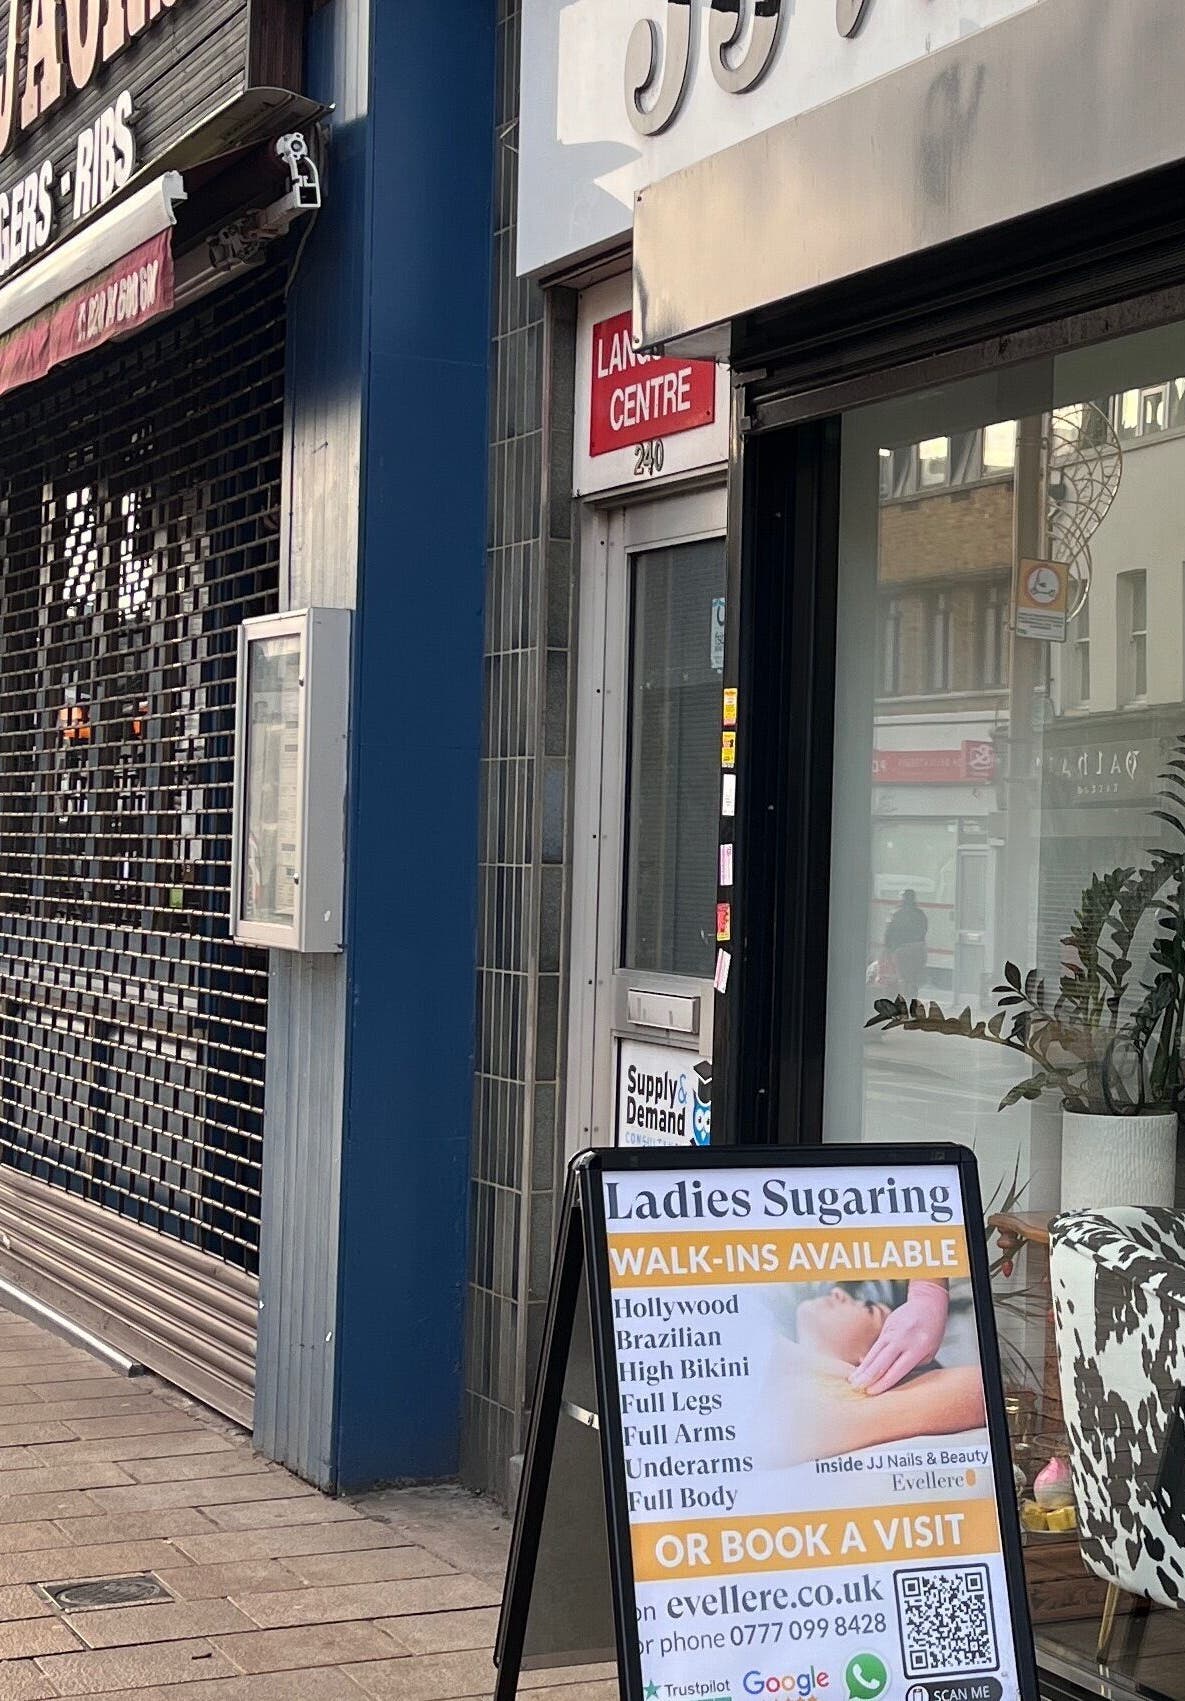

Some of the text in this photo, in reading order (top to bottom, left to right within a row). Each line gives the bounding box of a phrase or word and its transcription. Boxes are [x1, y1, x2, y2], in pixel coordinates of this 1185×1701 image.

[73, 90, 133, 220] RIBS
[610, 367, 692, 431] CENTRE
[634, 439, 664, 476] 240
[628, 1065, 687, 1109] Supply &
[627, 1096, 685, 1136] Demand
[607, 1178, 953, 1226] Ladies Sugaring
[611, 1238, 958, 1276] WALK-INS AVAILABLE
[614, 1294, 739, 1321] Hollywood
[617, 1329, 722, 1350] Brazilian
[619, 1357, 750, 1387] High Bikini
[622, 1390, 722, 1415] Full Legs
[624, 1423, 736, 1446] Full Arms
[625, 1453, 753, 1479] Underarms
[816, 1449, 989, 1474] inside JJ Nails & Beauty
[893, 1471, 964, 1492] Evellere
[628, 1484, 738, 1512] Full Body
[655, 1513, 966, 1569] OR BOOK A VISIT
[667, 1573, 885, 1618] evellere.co.uk
[660, 1630, 725, 1658] phone
[730, 1620, 784, 1648] 0777
[789, 1617, 831, 1642] 099
[834, 1612, 888, 1638] 8428
[664, 1665, 829, 1697] Trustpilot Google
[933, 1685, 991, 1701] SCAN ME
